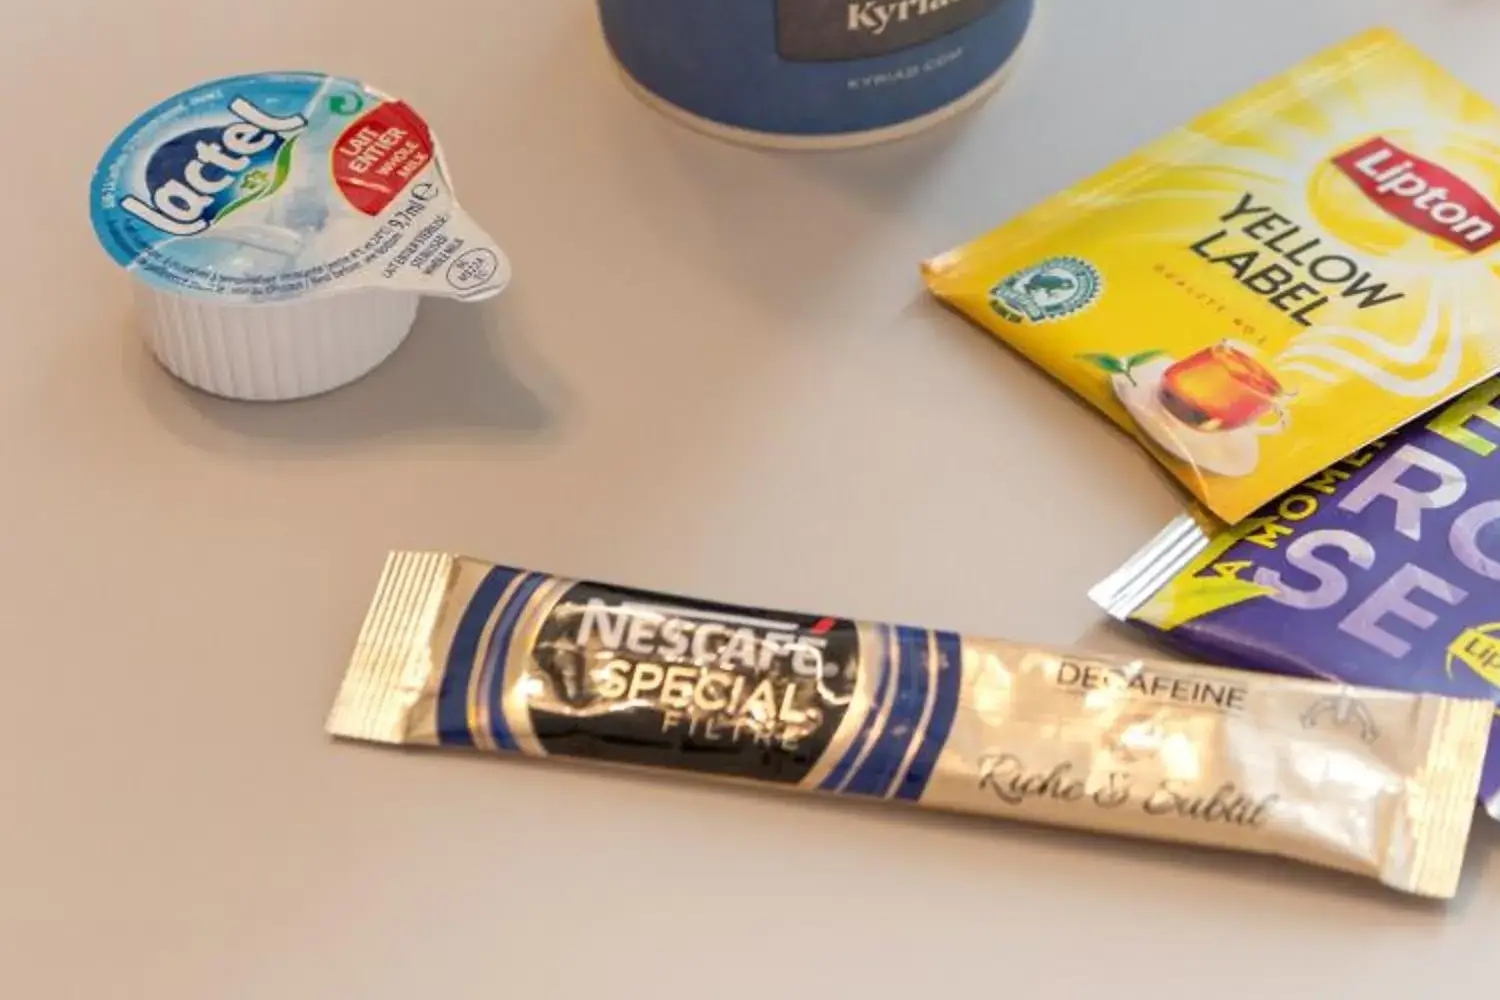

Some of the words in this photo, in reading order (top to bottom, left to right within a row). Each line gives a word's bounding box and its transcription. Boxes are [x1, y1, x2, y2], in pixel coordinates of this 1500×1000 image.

[121, 97, 308, 236] lactel
[340, 126, 379, 156] LAIT
[348, 127, 408, 174] ENTIER
[1353, 148, 1494, 243] Lipton
[1188, 229, 1329, 327] LABEL
[1219, 193, 1405, 309] YELLOW
[1252, 528, 1471, 660] SE
[976, 753, 1086, 805] Riche
